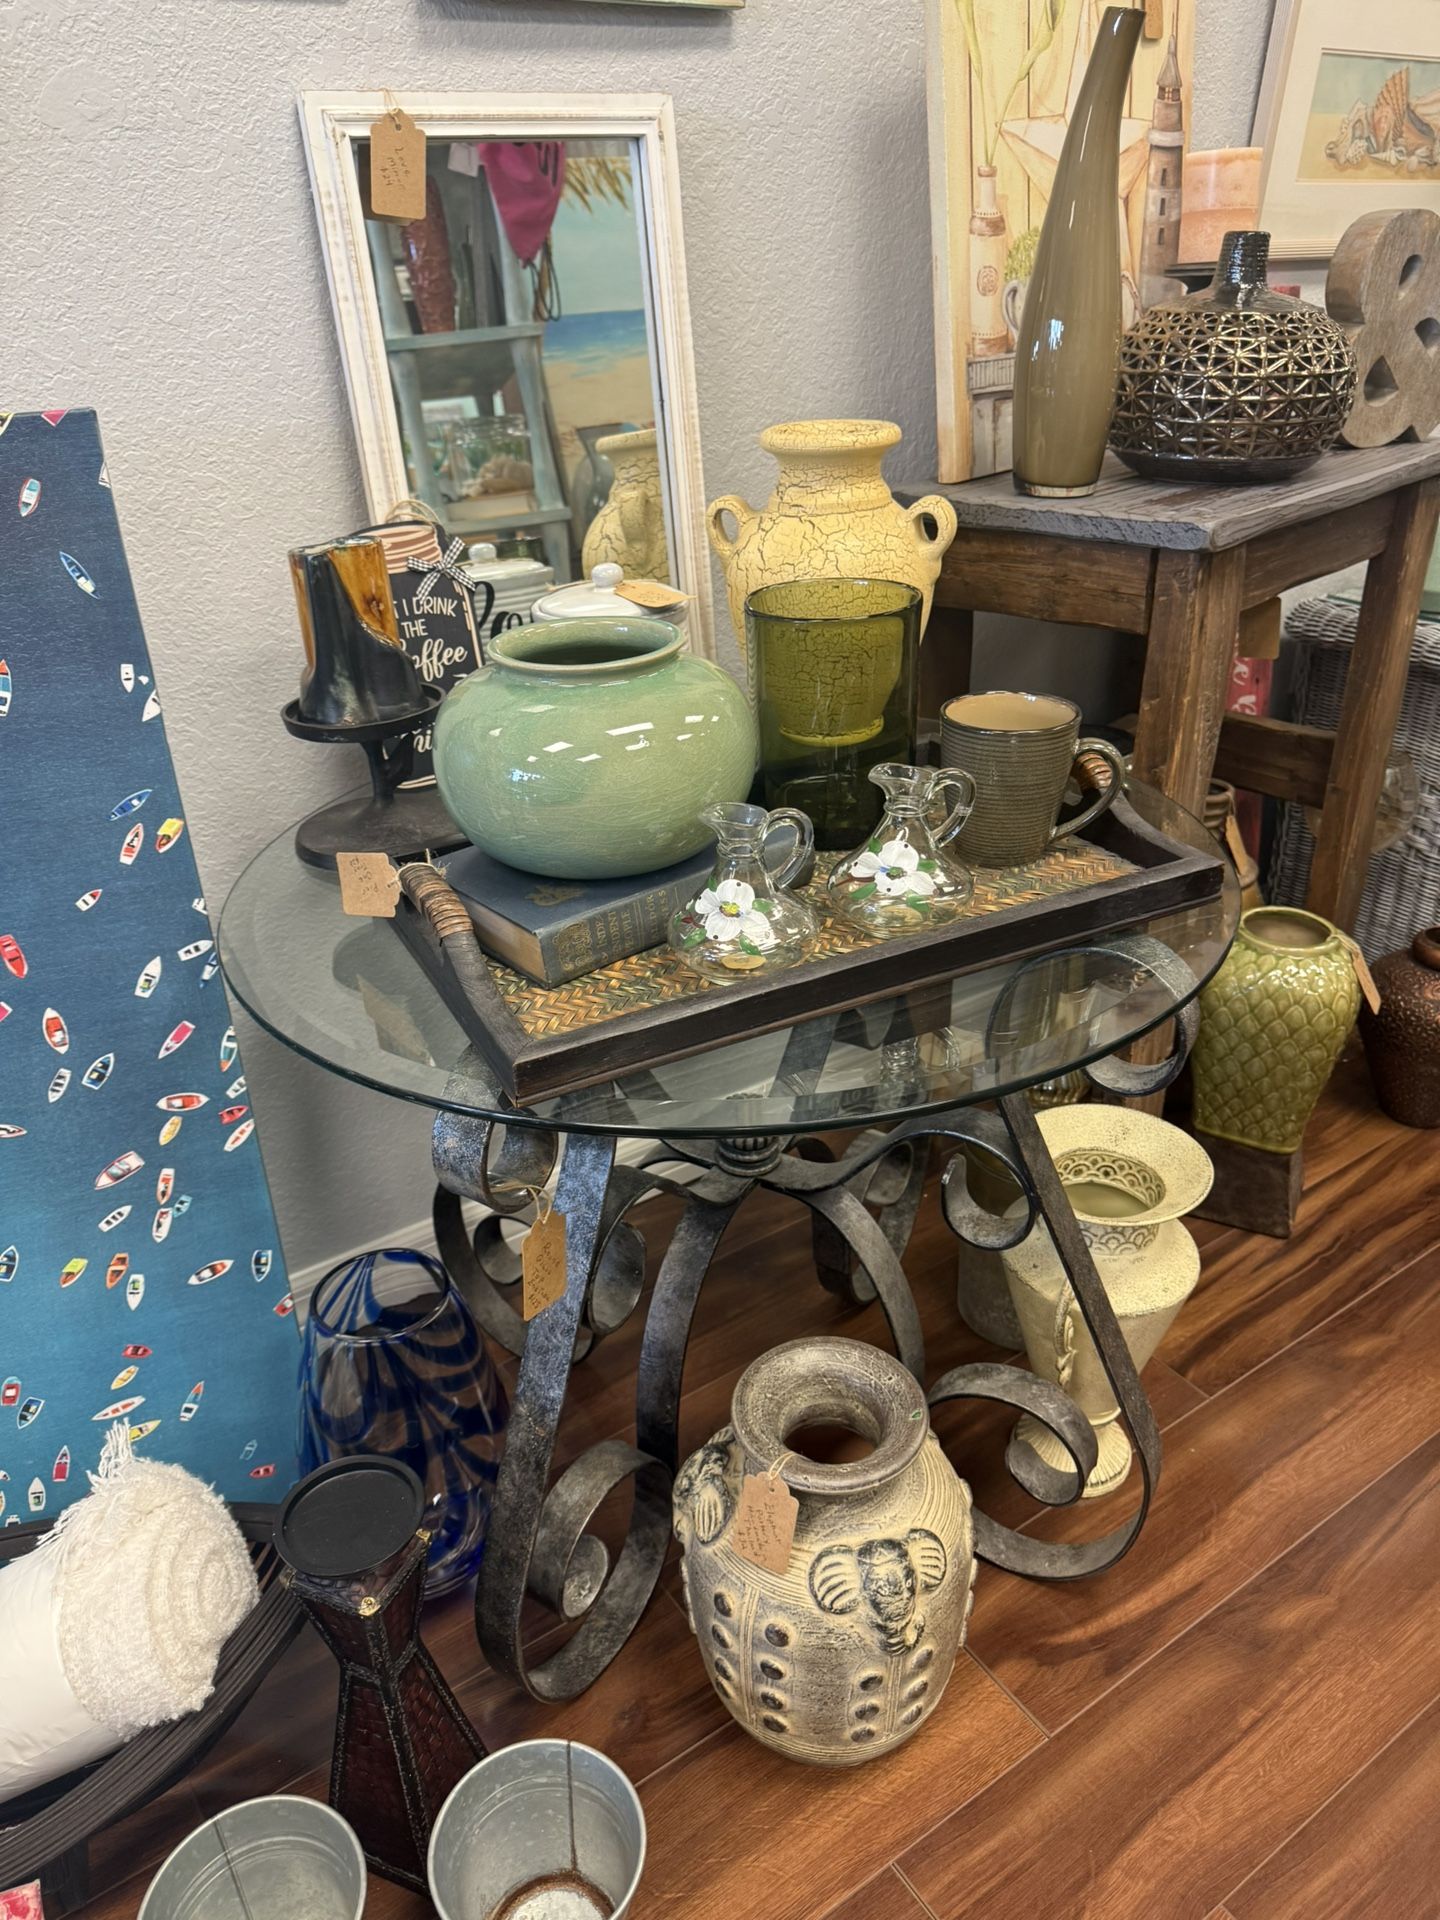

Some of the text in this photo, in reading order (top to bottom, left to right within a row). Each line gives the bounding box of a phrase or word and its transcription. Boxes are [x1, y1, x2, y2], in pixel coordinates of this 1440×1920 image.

[402, 598, 409, 616] I
[412, 595, 458, 618] DRINK
[400, 618, 428, 639] THE
